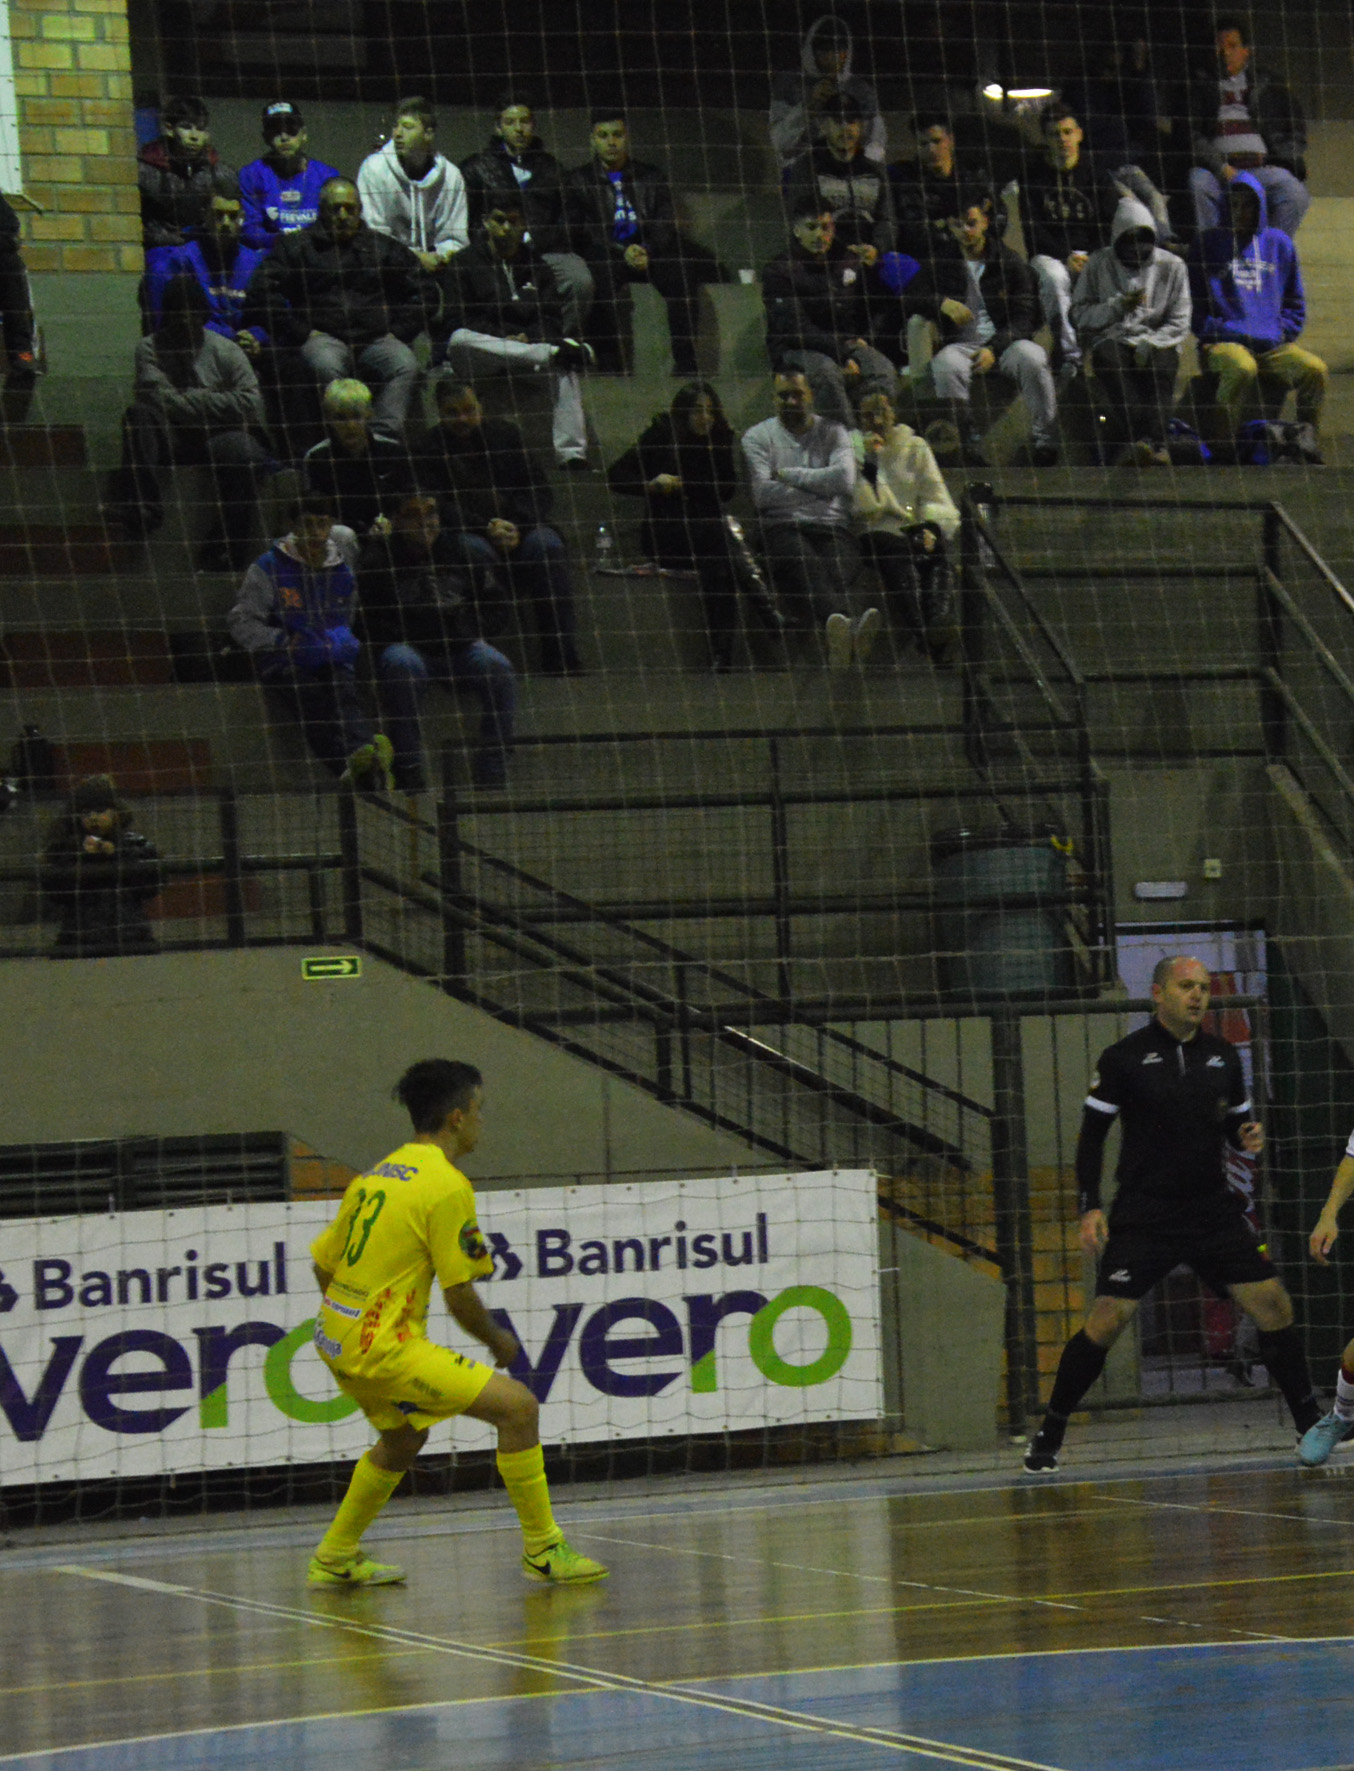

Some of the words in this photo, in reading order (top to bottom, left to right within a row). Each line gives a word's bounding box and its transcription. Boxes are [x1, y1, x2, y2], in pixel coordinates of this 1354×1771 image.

[34, 1242, 287, 1311] Banrisul
[537, 1212, 769, 1279] Banrisul
[492, 1284, 852, 1405] vero
